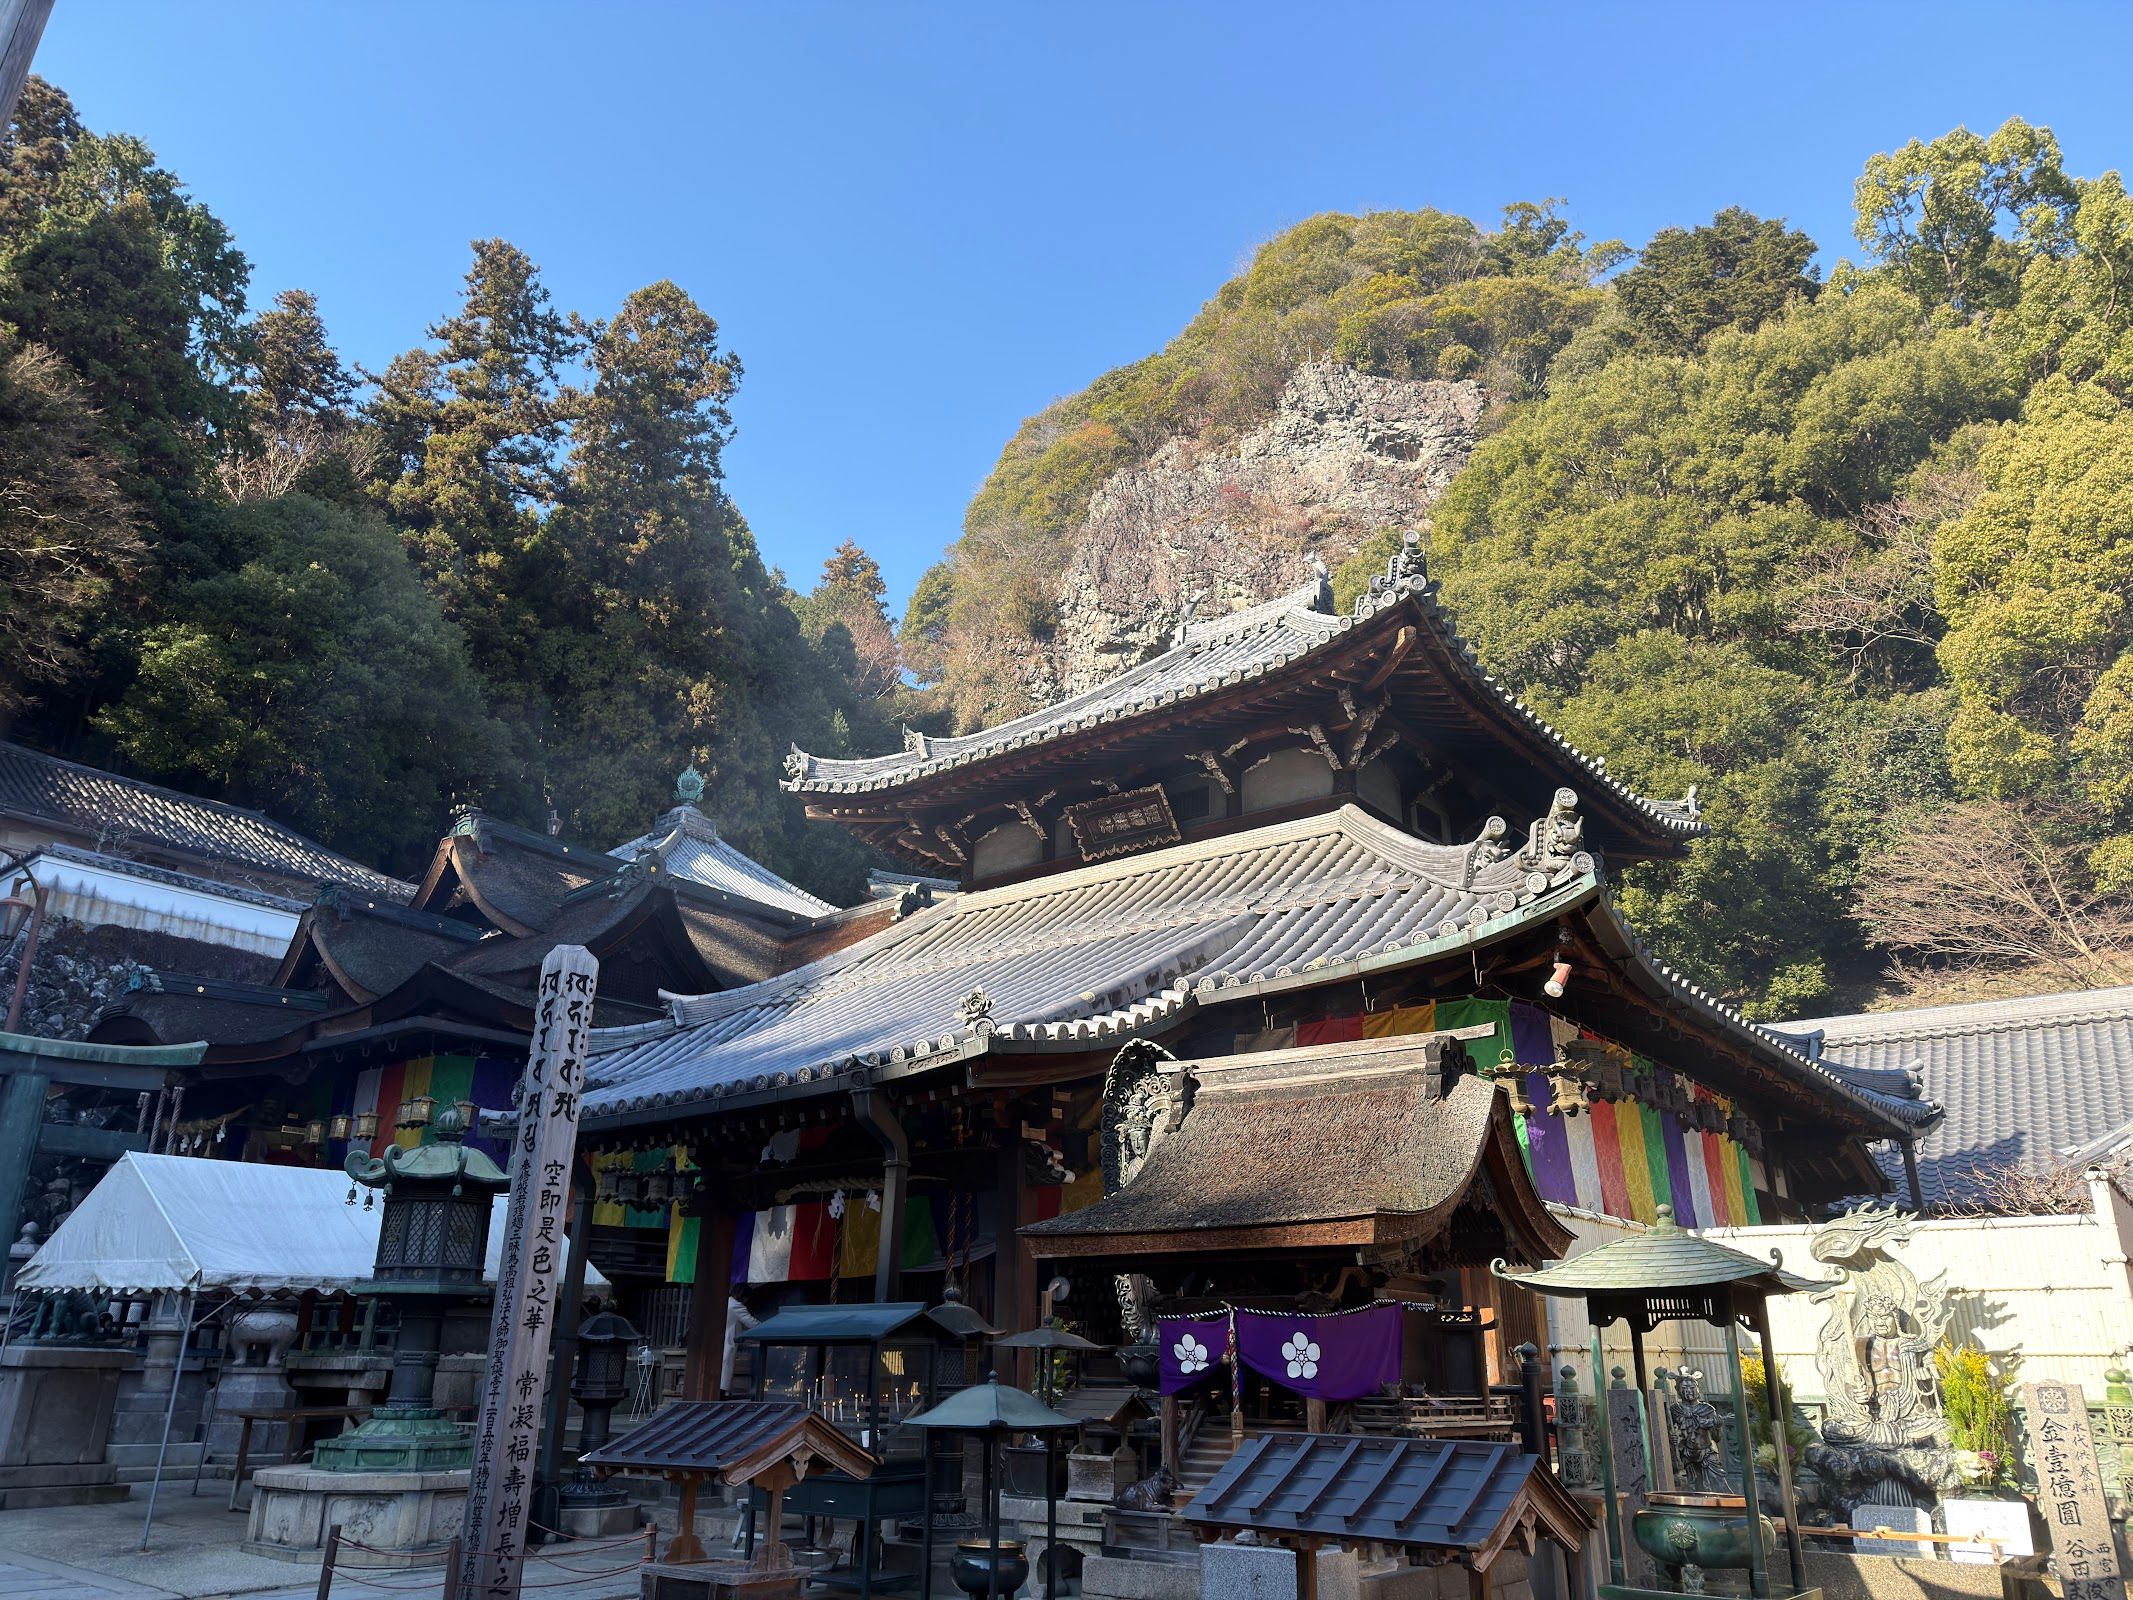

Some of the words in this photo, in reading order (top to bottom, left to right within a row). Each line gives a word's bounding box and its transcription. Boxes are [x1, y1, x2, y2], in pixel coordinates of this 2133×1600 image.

[523, 1160, 566, 1338] 空即是色之華
[2072, 1421, 2097, 1497] 永代供養料
[2065, 1539, 2093, 1578] 谷田
[2095, 1543, 2118, 1590] 西宮市
